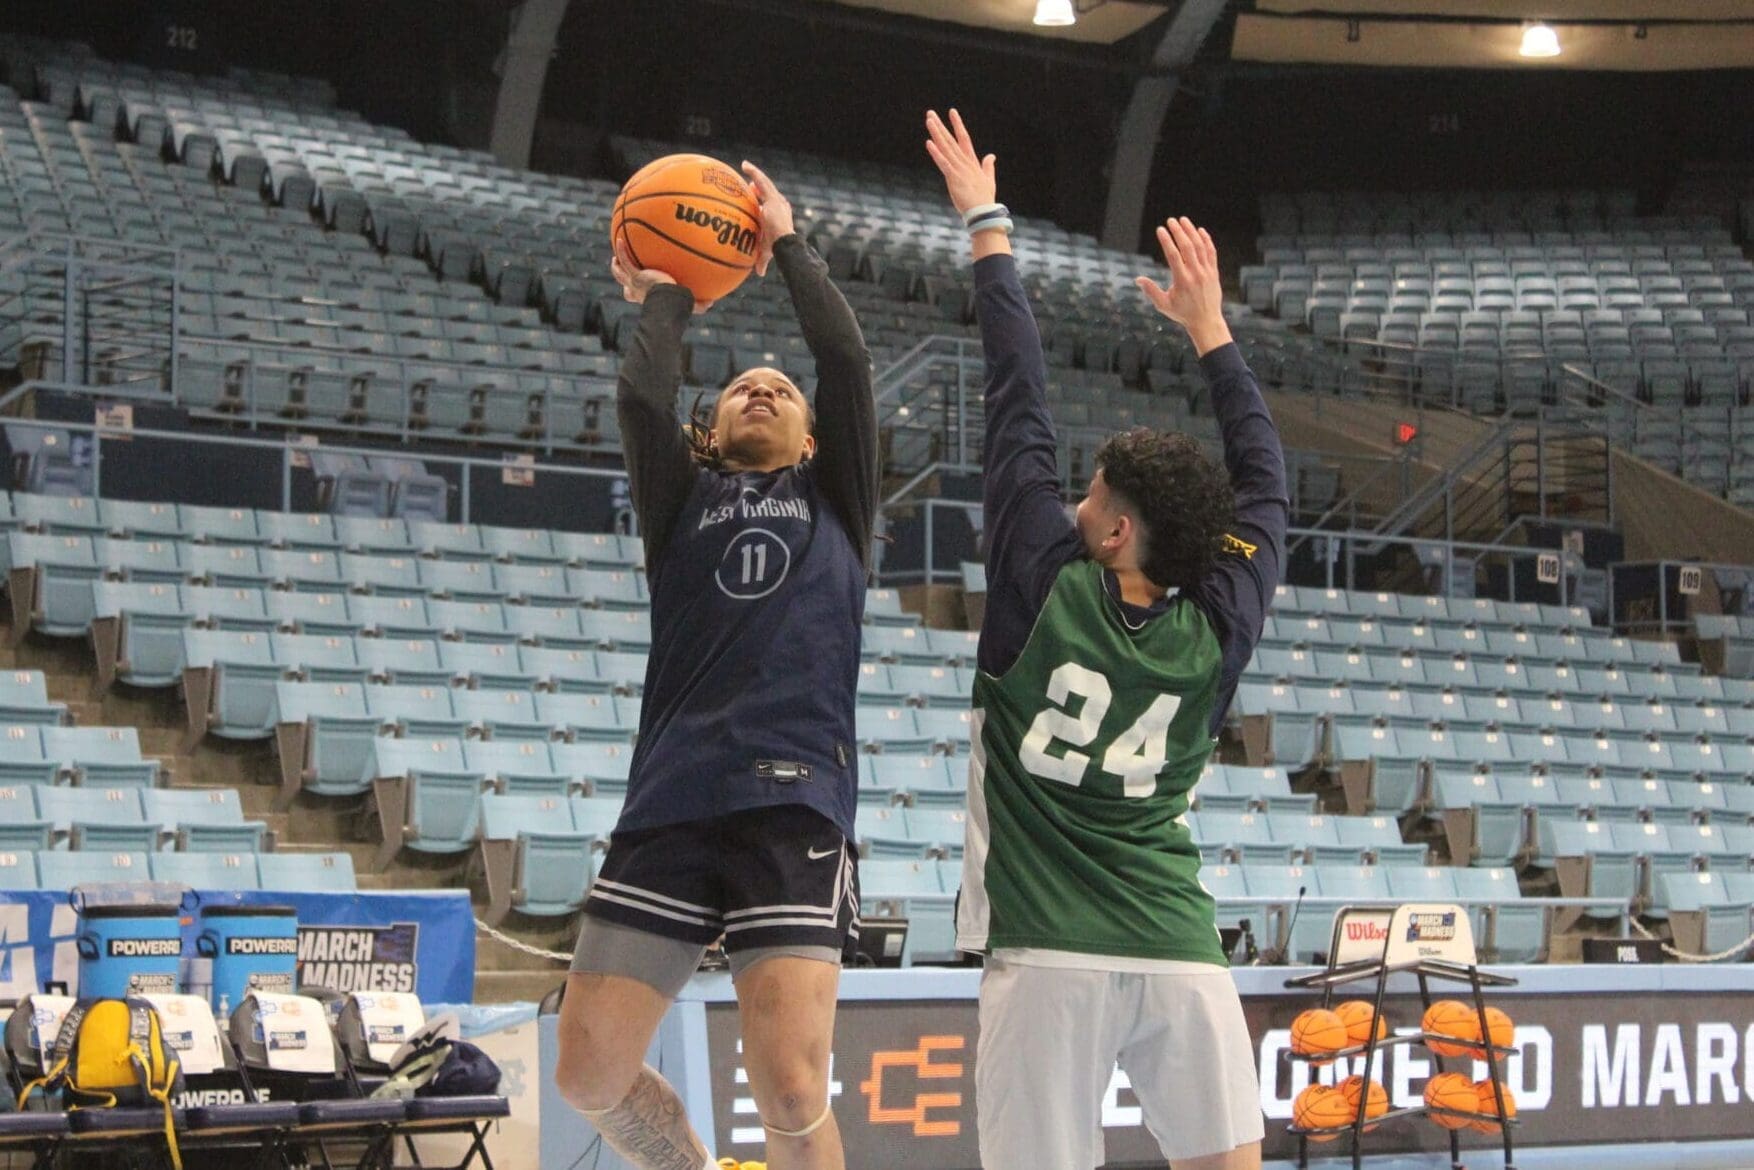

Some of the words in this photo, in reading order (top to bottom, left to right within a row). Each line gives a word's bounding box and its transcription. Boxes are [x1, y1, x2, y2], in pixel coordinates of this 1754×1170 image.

[166, 26, 197, 50] 212
[675, 203, 756, 257] Wilson
[741, 543, 767, 584] 11
[1019, 662, 1181, 798] 24
[298, 930, 374, 961] MARCH
[1346, 922, 1389, 941] Wilso
[302, 961, 413, 993] MADNESS
[1582, 1022, 1754, 1107] MAR
